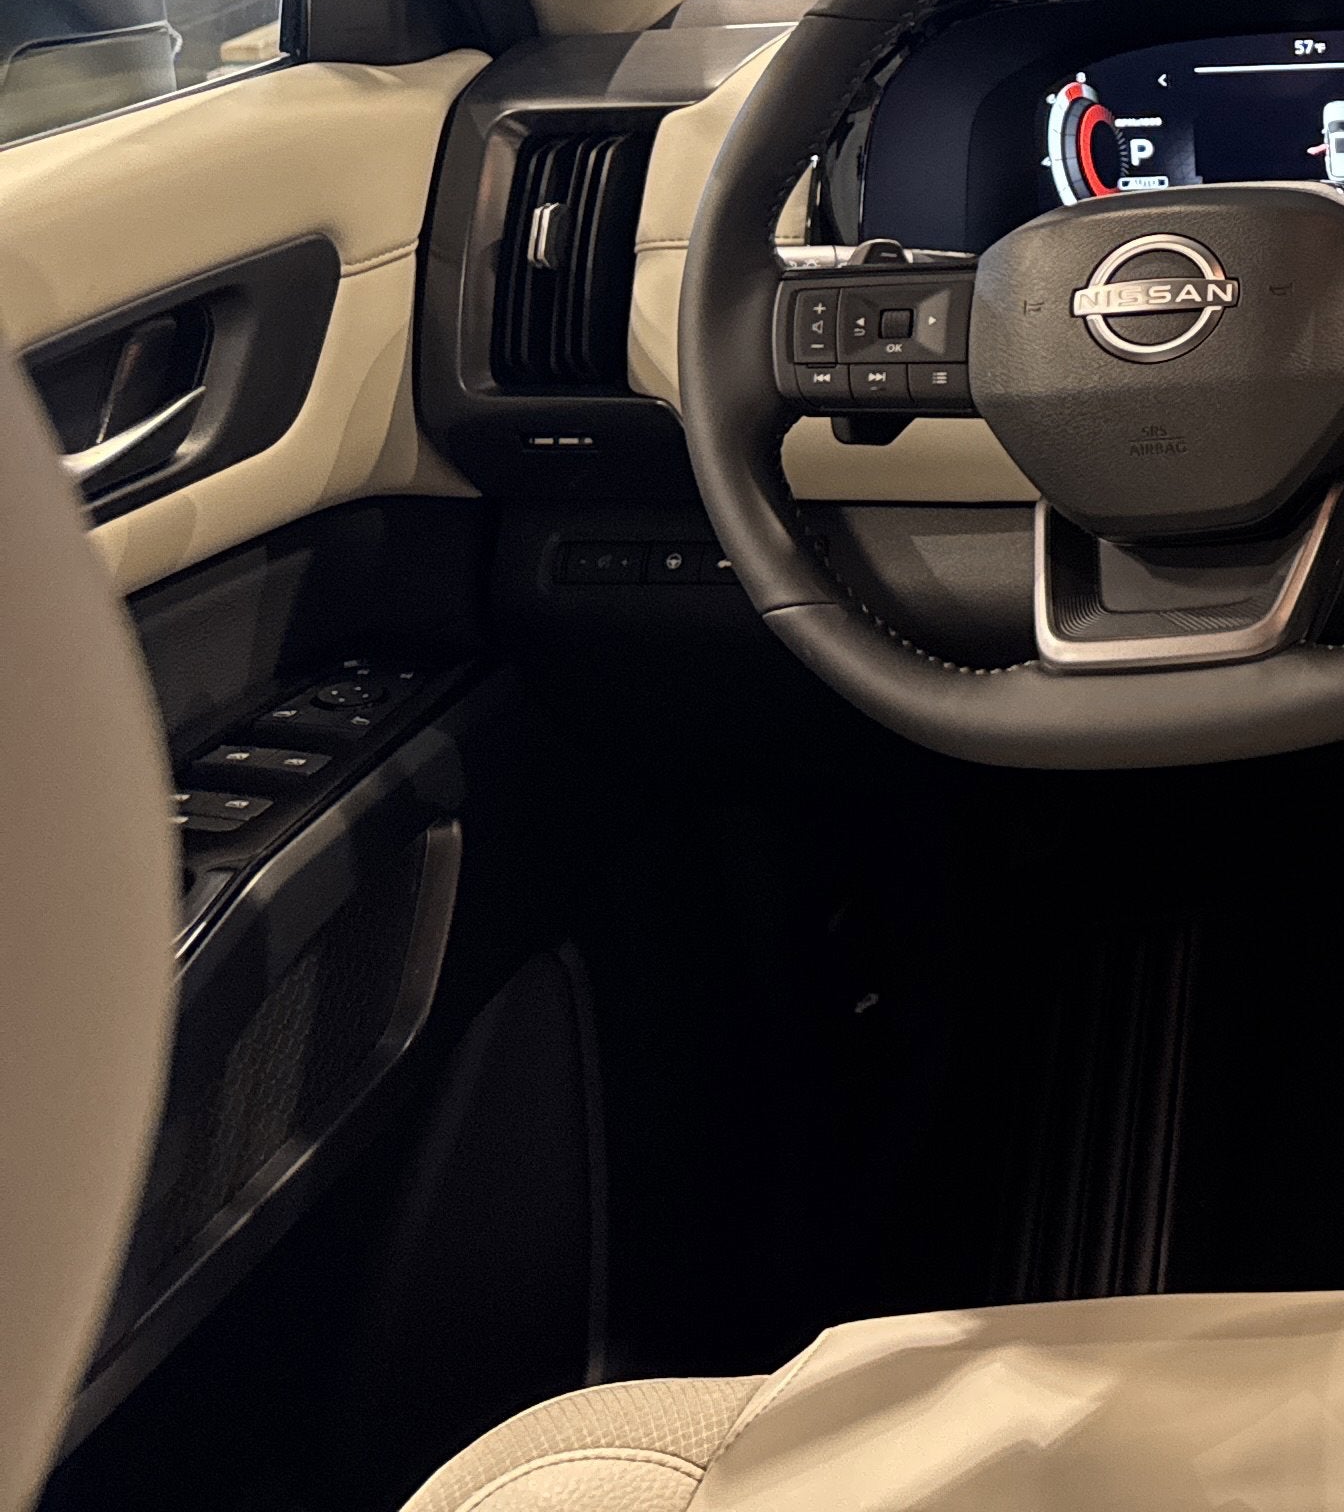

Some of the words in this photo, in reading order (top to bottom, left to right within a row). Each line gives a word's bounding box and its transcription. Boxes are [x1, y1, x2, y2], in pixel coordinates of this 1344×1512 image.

[1129, 138, 1154, 167] P
[1078, 283, 1233, 310] NISSAN
[886, 343, 903, 353] OK
[1141, 425, 1168, 437] SRS
